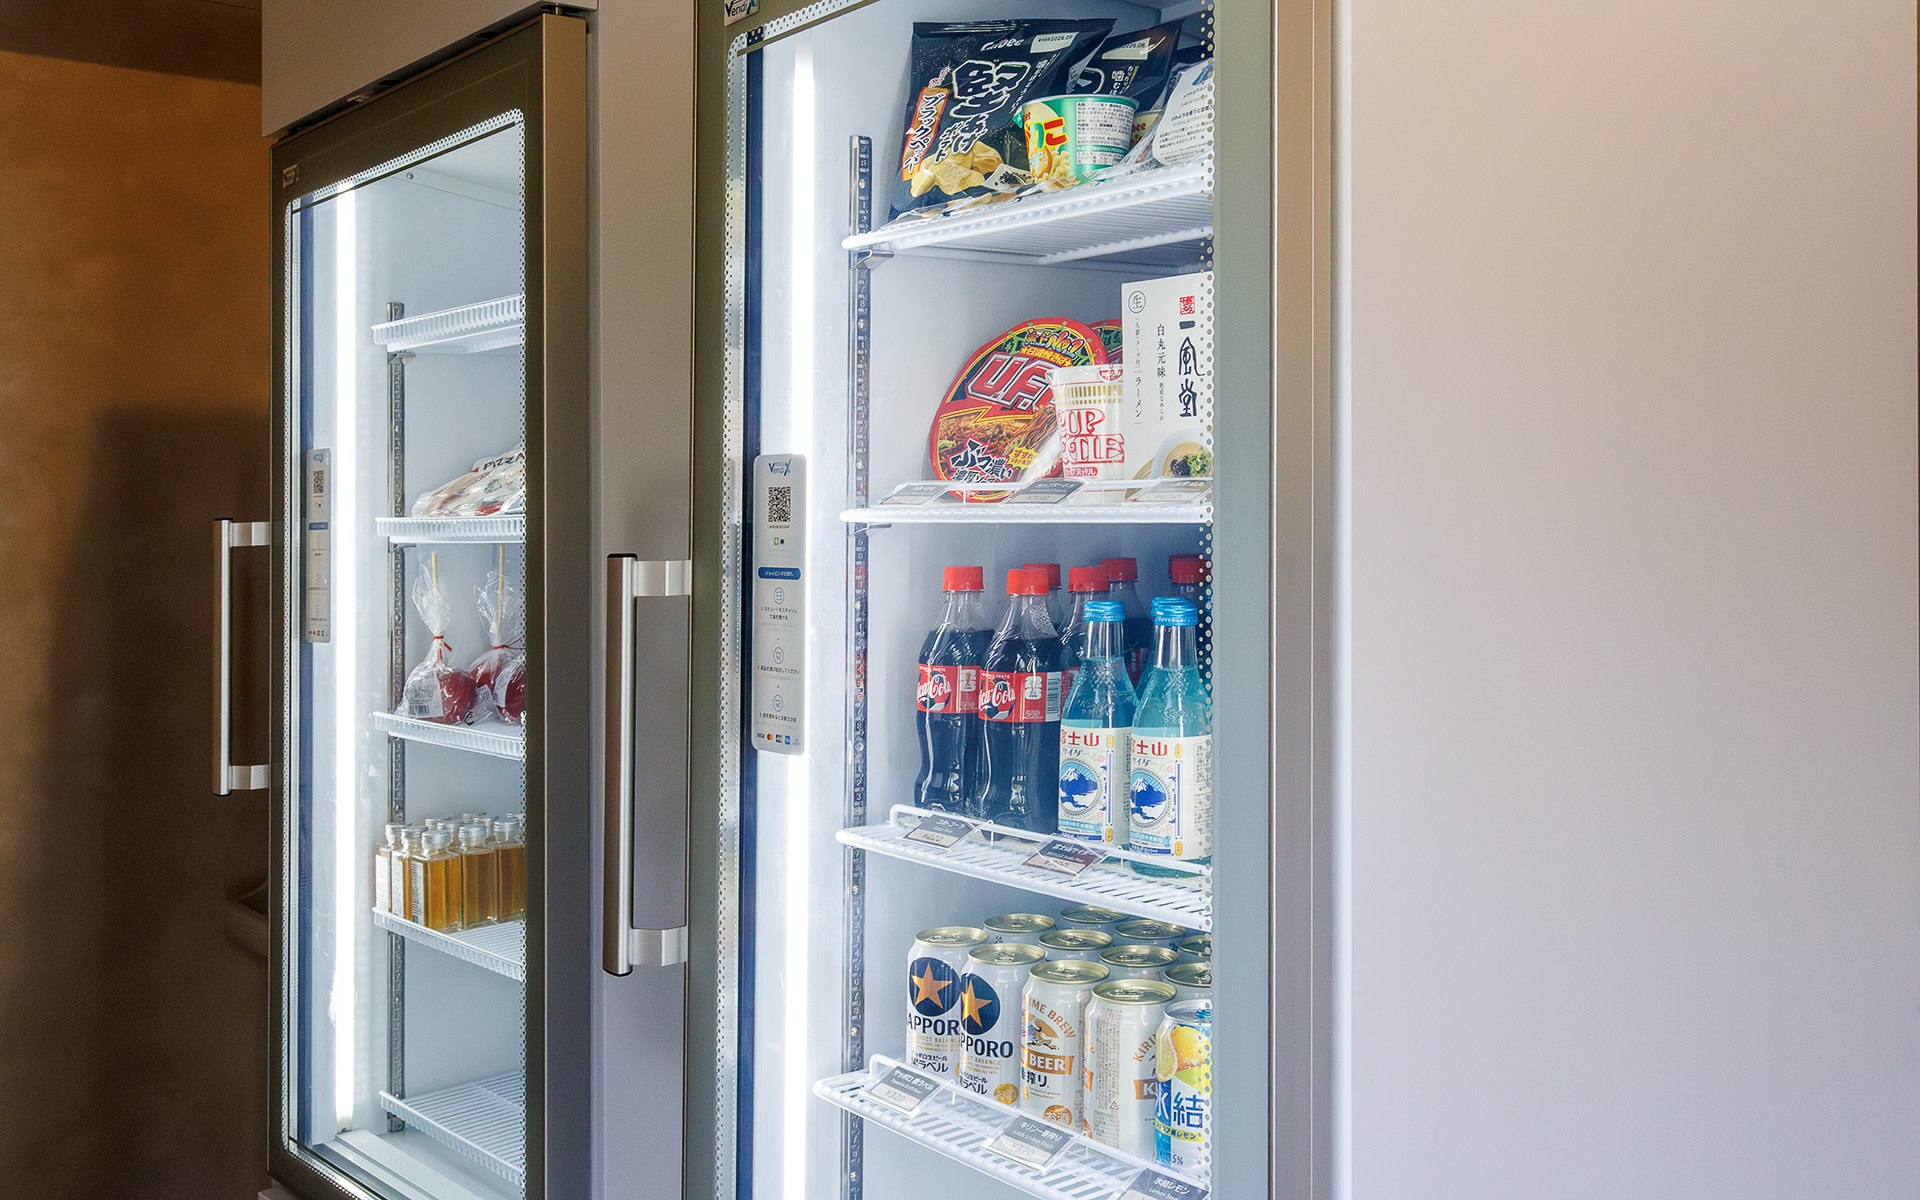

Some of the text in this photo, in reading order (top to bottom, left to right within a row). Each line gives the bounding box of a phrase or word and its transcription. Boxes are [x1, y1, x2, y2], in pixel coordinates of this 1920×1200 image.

[1132, 294, 1143, 309] 生
[1156, 323, 1166, 378] 白丸元味
[1178, 320, 1205, 418] 一風堂
[1134, 376, 1143, 418] ラーメン
[483, 452, 525, 470] PIZZA
[950, 438, 1013, 480] ぶっ濃い
[1047, 1010, 1076, 1038] BREW
[1029, 1053, 1066, 1071] BEER
[884, 1089, 906, 1102] ¥320
[1020, 1121, 1062, 1141] キリン一番搾り
[1153, 1176, 1191, 1195] 氷結レモン
